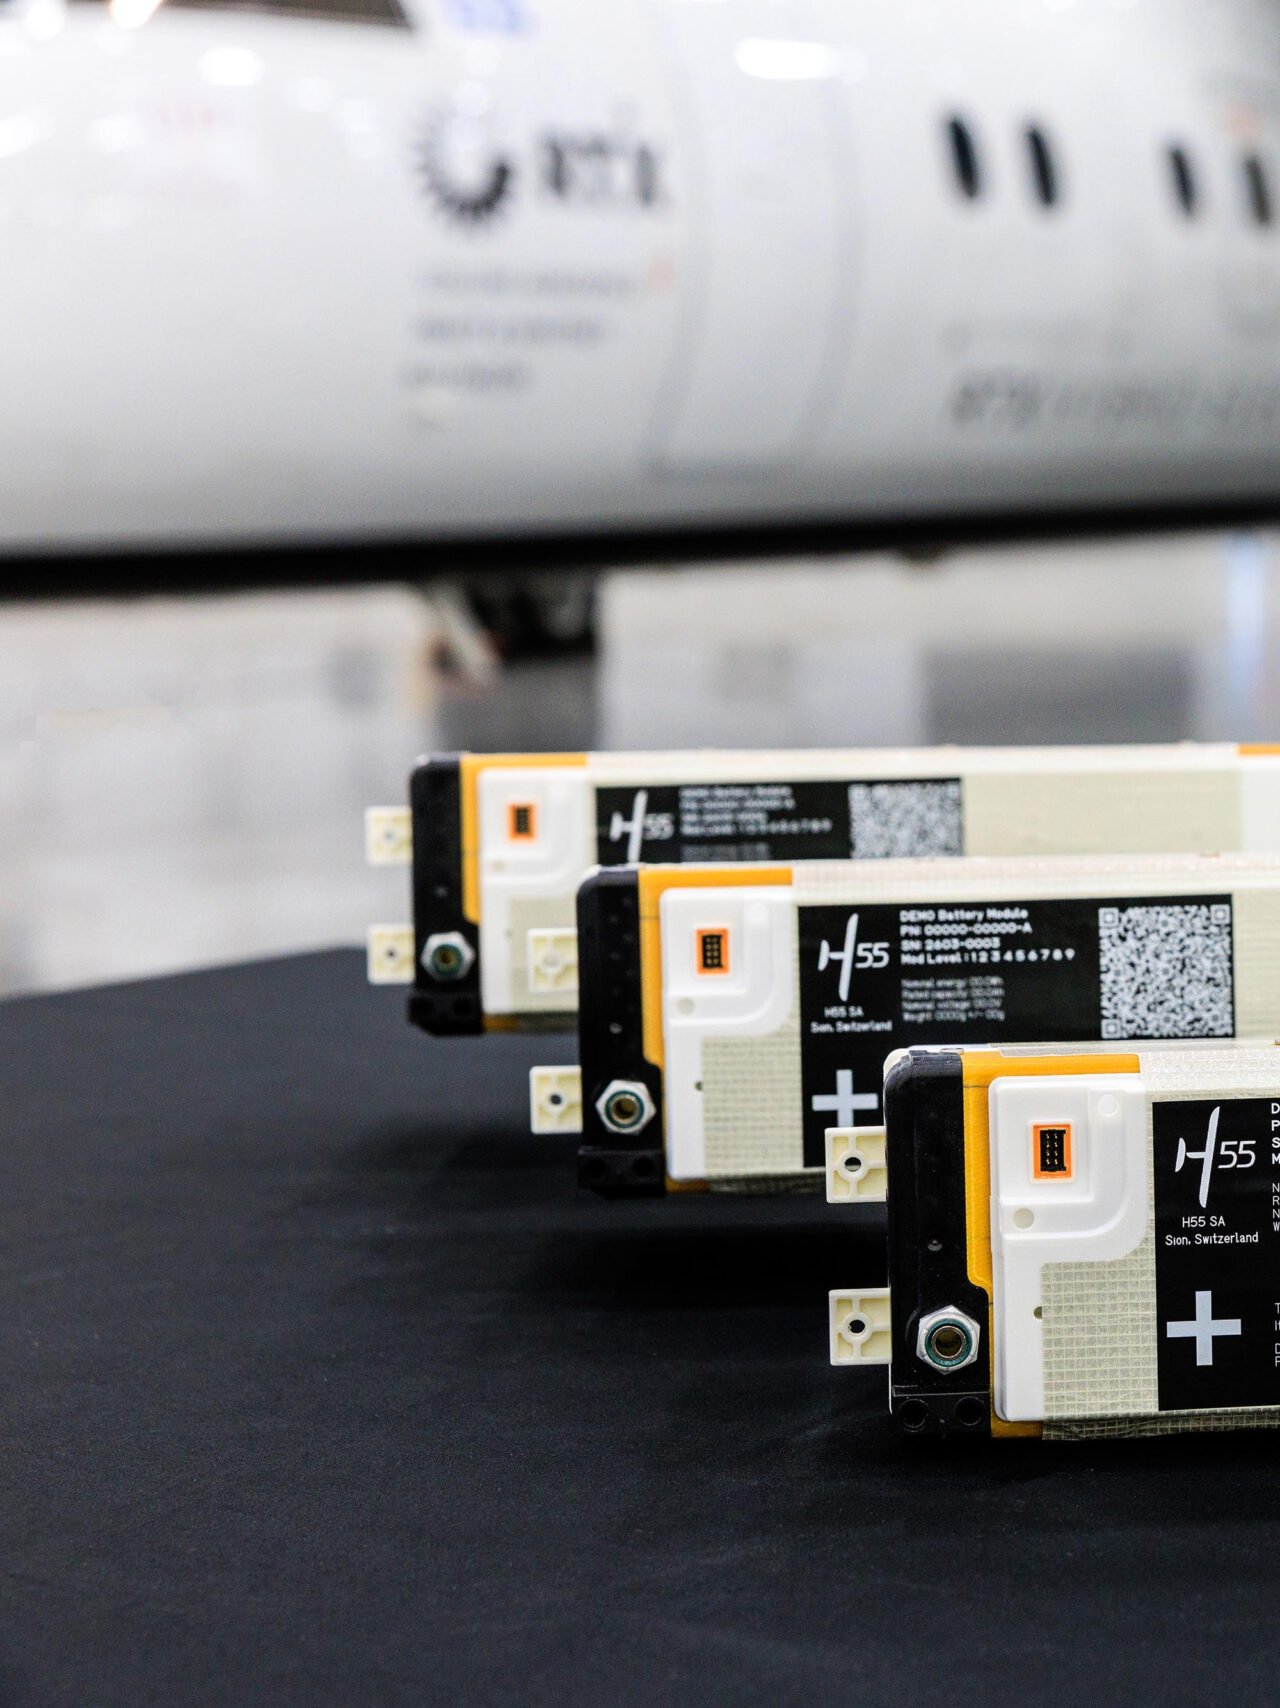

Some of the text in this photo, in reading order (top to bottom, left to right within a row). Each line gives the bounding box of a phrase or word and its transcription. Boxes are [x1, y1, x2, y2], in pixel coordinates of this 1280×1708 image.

[900, 907, 1028, 922] DEMO Battery Module
[818, 913, 889, 1002] H55
[901, 953, 924, 965] Mod
[1175, 1106, 1256, 1208] H55
[1182, 1216, 1225, 1227] H55 SA
[1195, 1232, 1259, 1244] Switzerland
